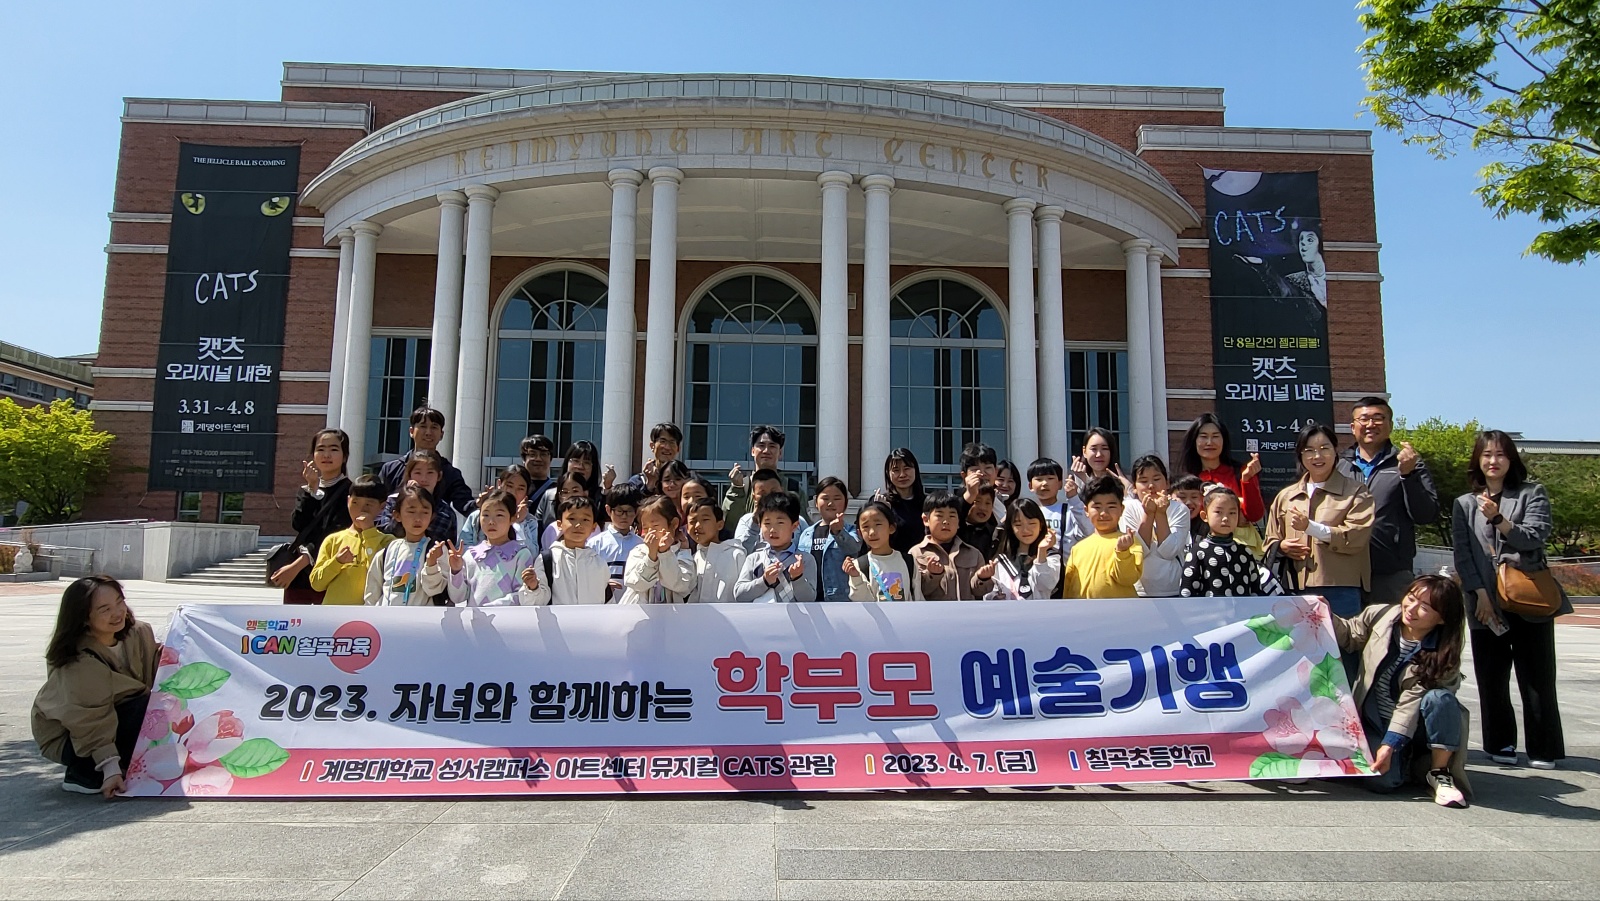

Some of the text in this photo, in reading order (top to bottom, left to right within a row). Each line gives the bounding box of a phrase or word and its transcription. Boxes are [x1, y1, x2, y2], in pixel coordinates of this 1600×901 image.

[192, 156, 206, 164] THE
[206, 157, 235, 166] JELLICLE
[454, 128, 688, 175] KEIMYUNG
[883, 137, 1049, 192] CENTER
[1214, 205, 1286, 246] CATS
[195, 269, 260, 304] CATS
[197, 336, 245, 361] 캣츠
[1223, 337, 1234, 348] 단
[1236, 337, 1277, 349] 8일간의
[165, 363, 272, 383] 오리지널 내한
[1251, 356, 1298, 380] 캣츠
[1225, 383, 1326, 402] 오리지널 내한
[196, 422, 250, 432] 계명아트센터
[1260, 441, 1297, 451] 계명아트
[297, 636, 372, 657] 칠곡교육
[259, 642, 1251, 724] 2023. 자녀와 함께하는 학부모 예술기행
[317, 758, 434, 782] 계명대학교
[437, 757, 551, 782] 성서캠퍼스
[555, 756, 647, 780] 아트센터
[649, 756, 720, 779] 뮤지컬
[723, 756, 785, 777] CATS
[788, 755, 836, 777] 관람
[1085, 745, 1216, 771] 칠곡초등학교
